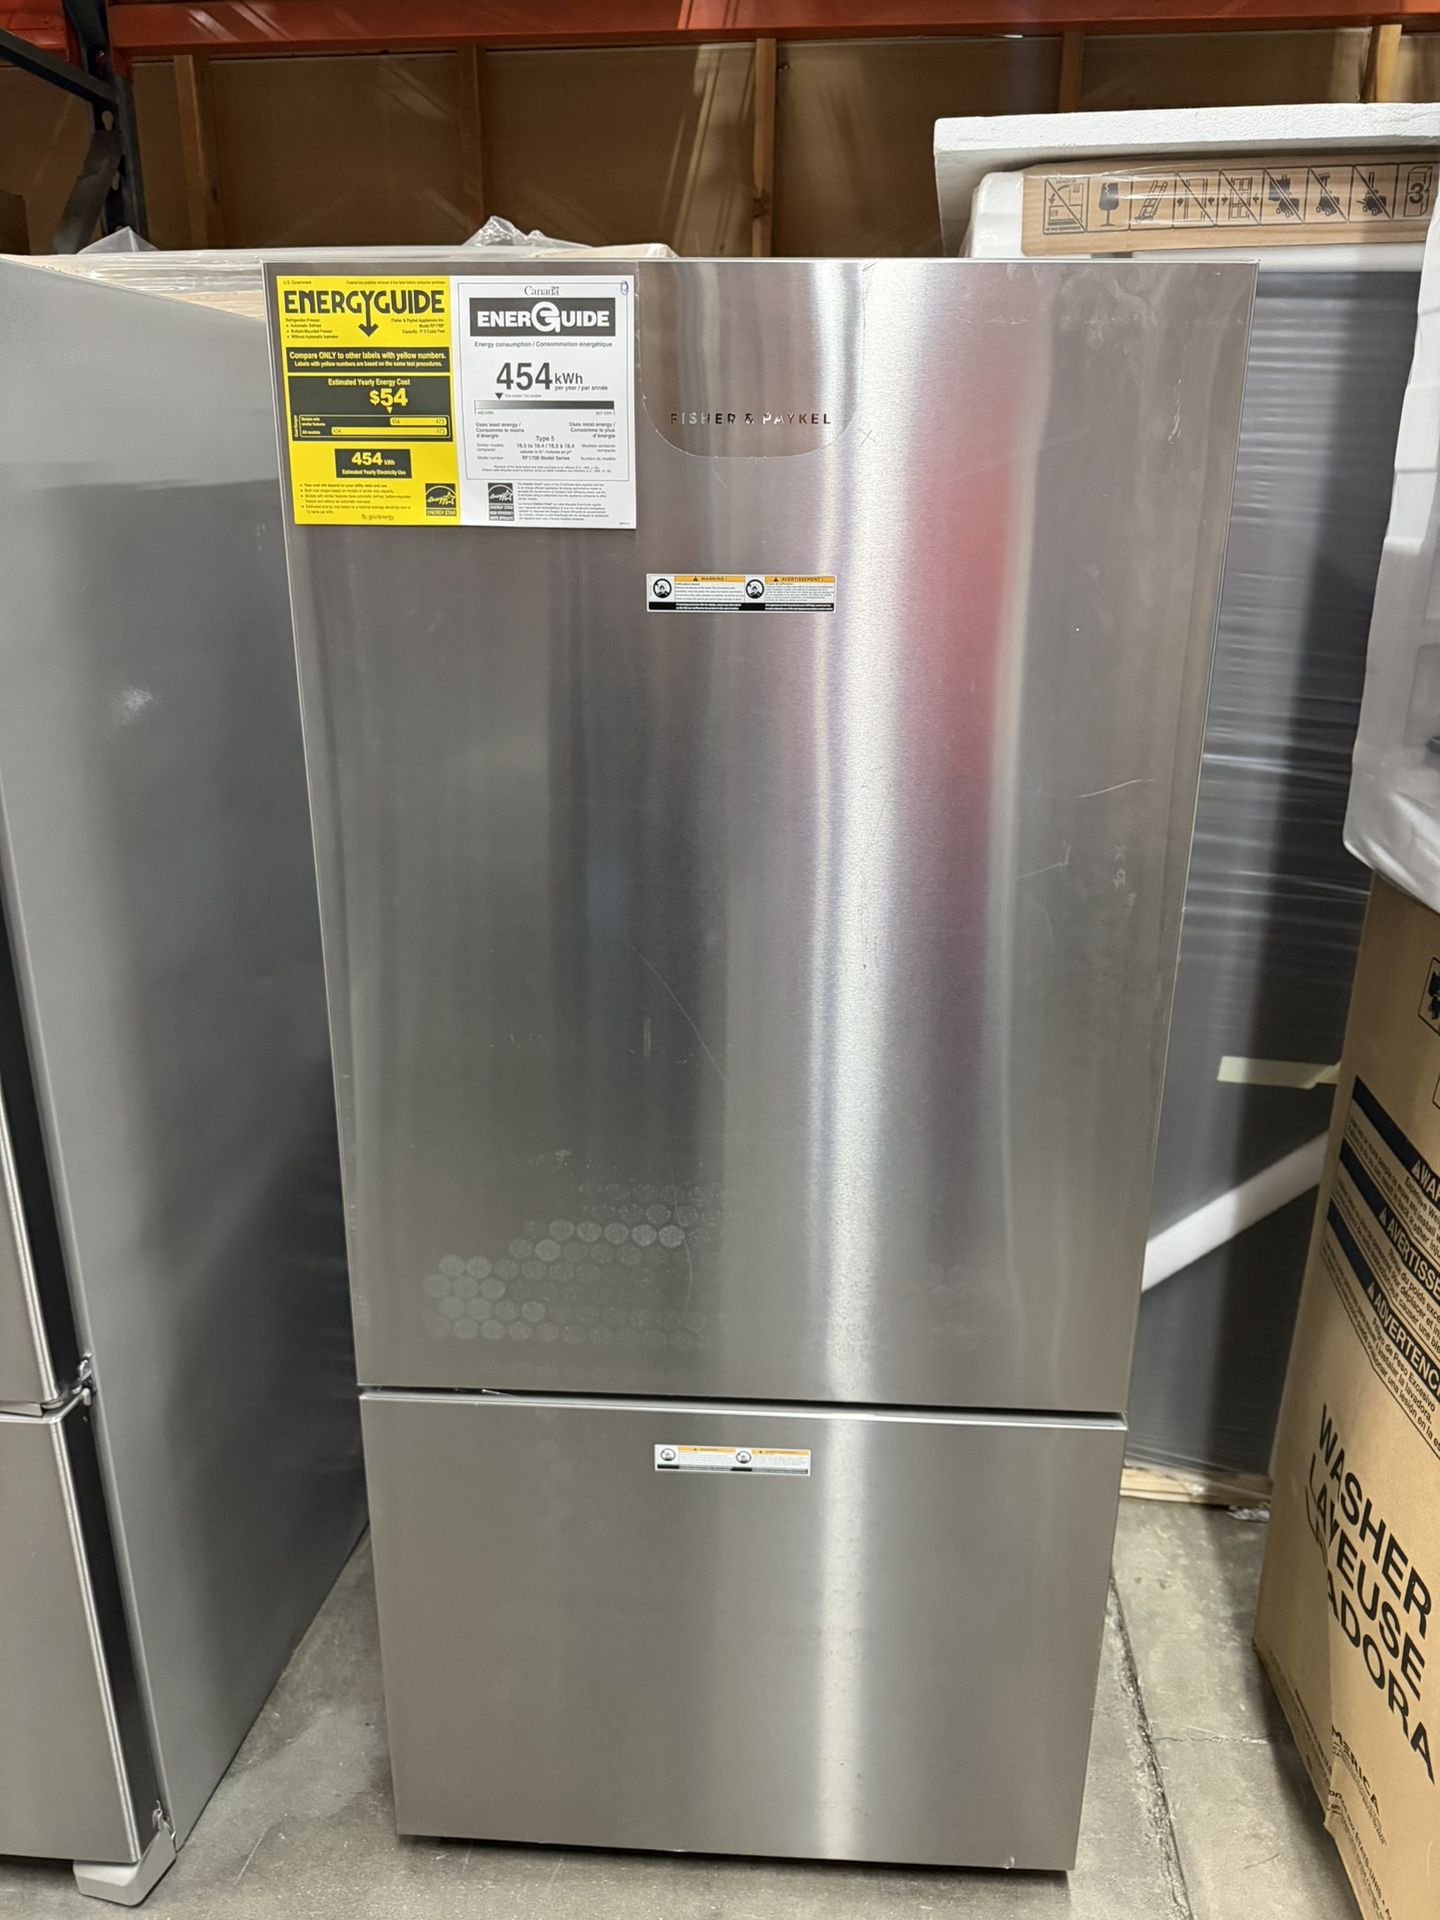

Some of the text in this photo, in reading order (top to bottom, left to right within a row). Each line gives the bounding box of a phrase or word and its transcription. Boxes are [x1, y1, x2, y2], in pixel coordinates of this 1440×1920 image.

[283, 290, 445, 315] ENERGYGUIDE
[476, 301, 611, 333] ENERGUIDE
[289, 351, 318, 360] Compare
[318, 351, 337, 359] ONLY
[345, 351, 361, 359] other
[362, 351, 381, 359] labels
[381, 351, 396, 359] with
[396, 351, 417, 361] yellow
[328, 378, 411, 388] Estimated Yearly Energy Cost
[496, 362, 583, 390] 454 kWh
[369, 387, 409, 407] $54
[670, 412, 832, 425] FISHER & PAYKEL
[351, 451, 384, 466] 454
[1373, 1293, 1440, 1397] ADVERTENC
[1404, 1381, 1433, 1425] lavadora.
[1407, 1372, 1437, 1413] Excesivo
[1416, 1414, 1428, 1432] en
[1319, 1402, 1431, 1640] WASHER
[1309, 1452, 1425, 1702] LAVEUSE
